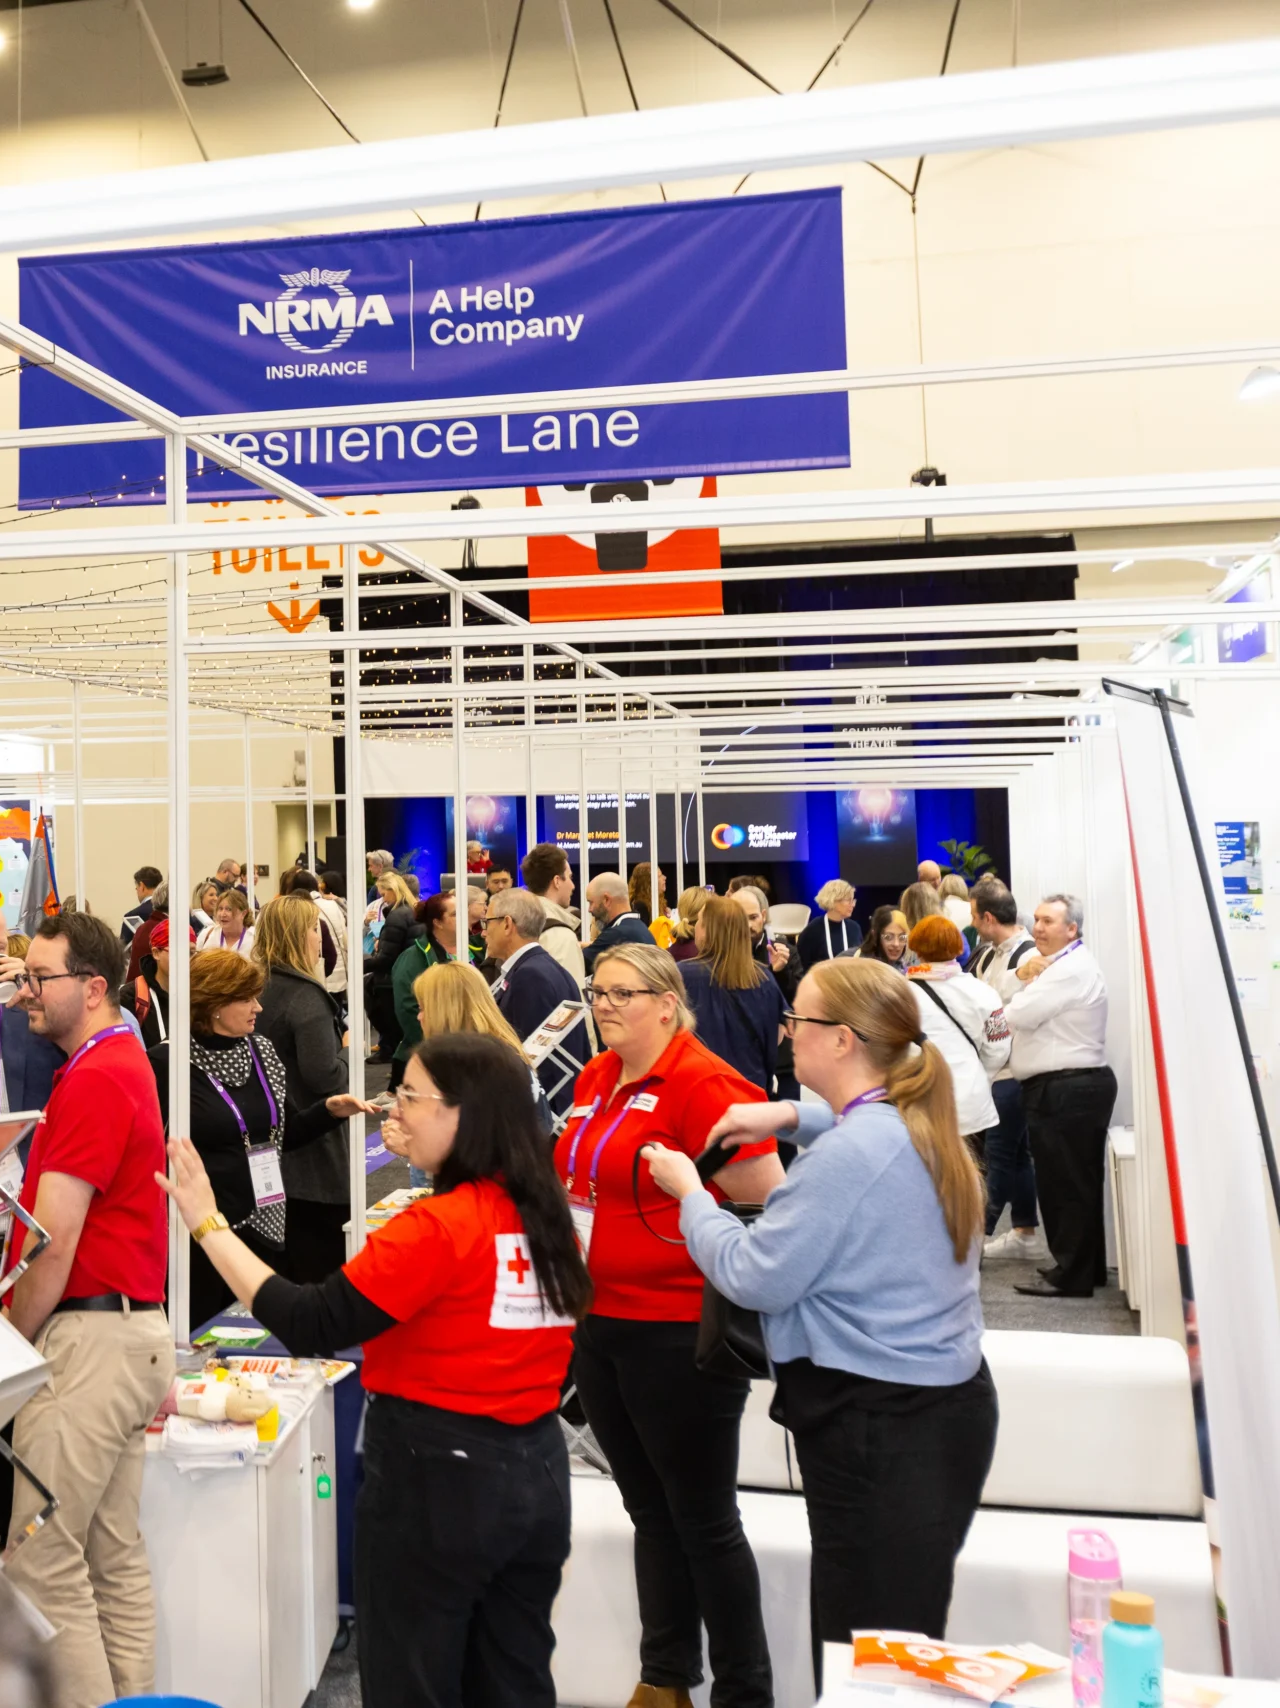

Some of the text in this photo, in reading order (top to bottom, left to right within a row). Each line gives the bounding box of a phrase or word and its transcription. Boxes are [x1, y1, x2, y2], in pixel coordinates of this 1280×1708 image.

[238, 294, 395, 336] NRMA
[428, 282, 535, 315] A Help
[429, 313, 585, 346] Company
[266, 360, 368, 380] INSURANCE
[500, 408, 640, 455] Lane
